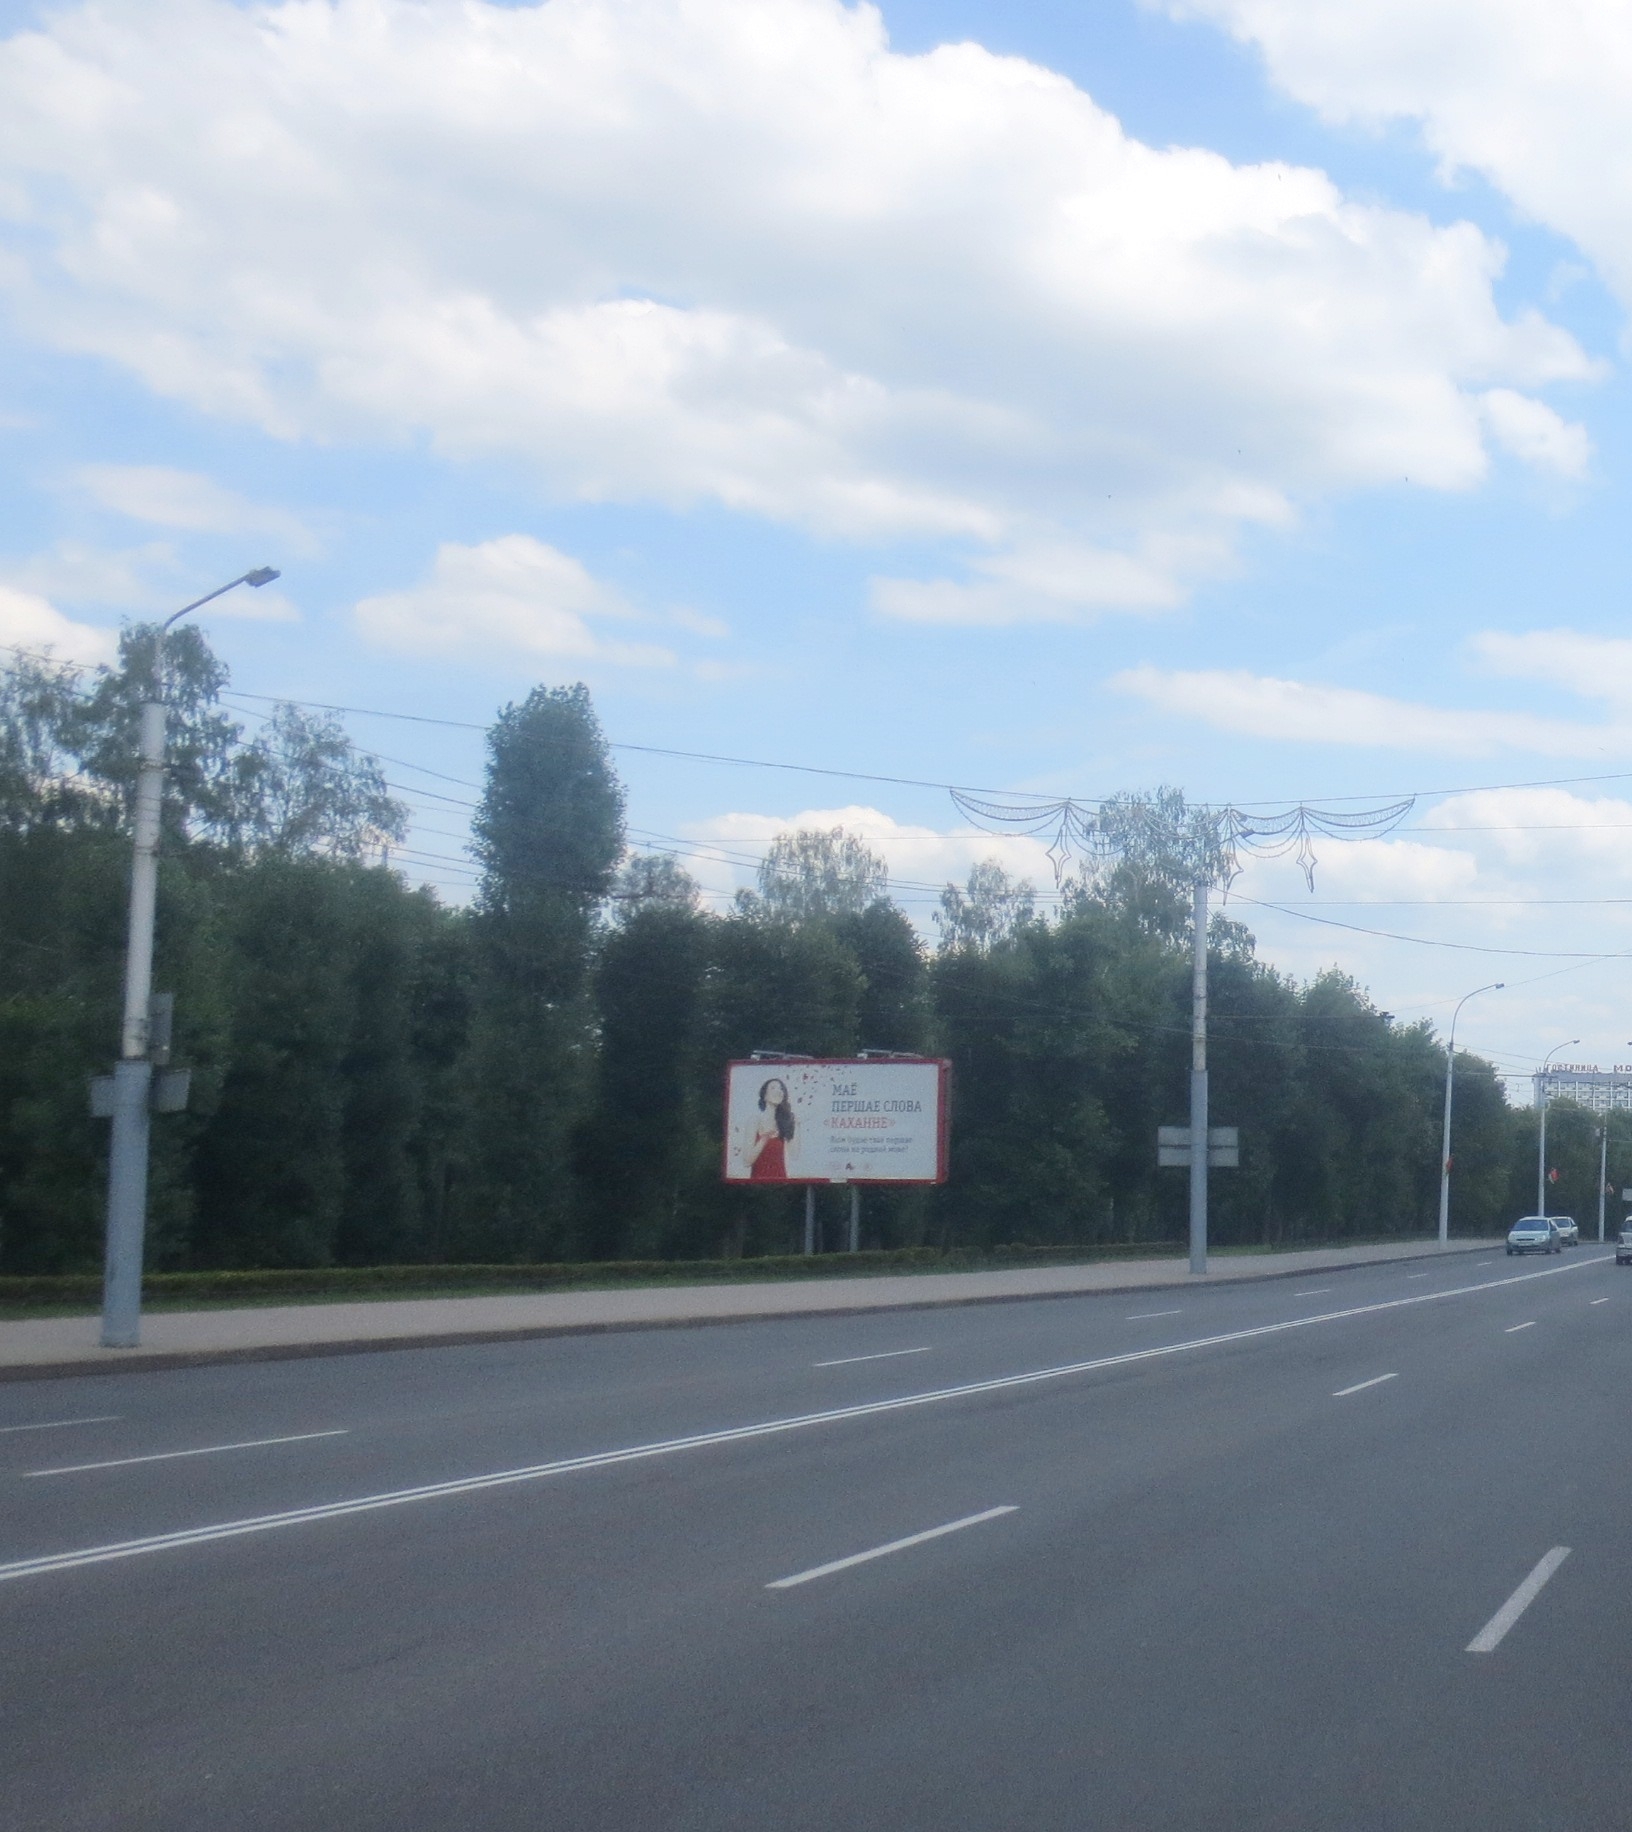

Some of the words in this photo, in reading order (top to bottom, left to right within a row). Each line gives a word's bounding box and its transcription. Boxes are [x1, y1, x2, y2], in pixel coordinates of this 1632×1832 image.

[832, 1082, 857, 1096] МАЁ
[831, 1100, 880, 1112] ПЕРШАЕ
[883, 1100, 922, 1112] СЛОВА
